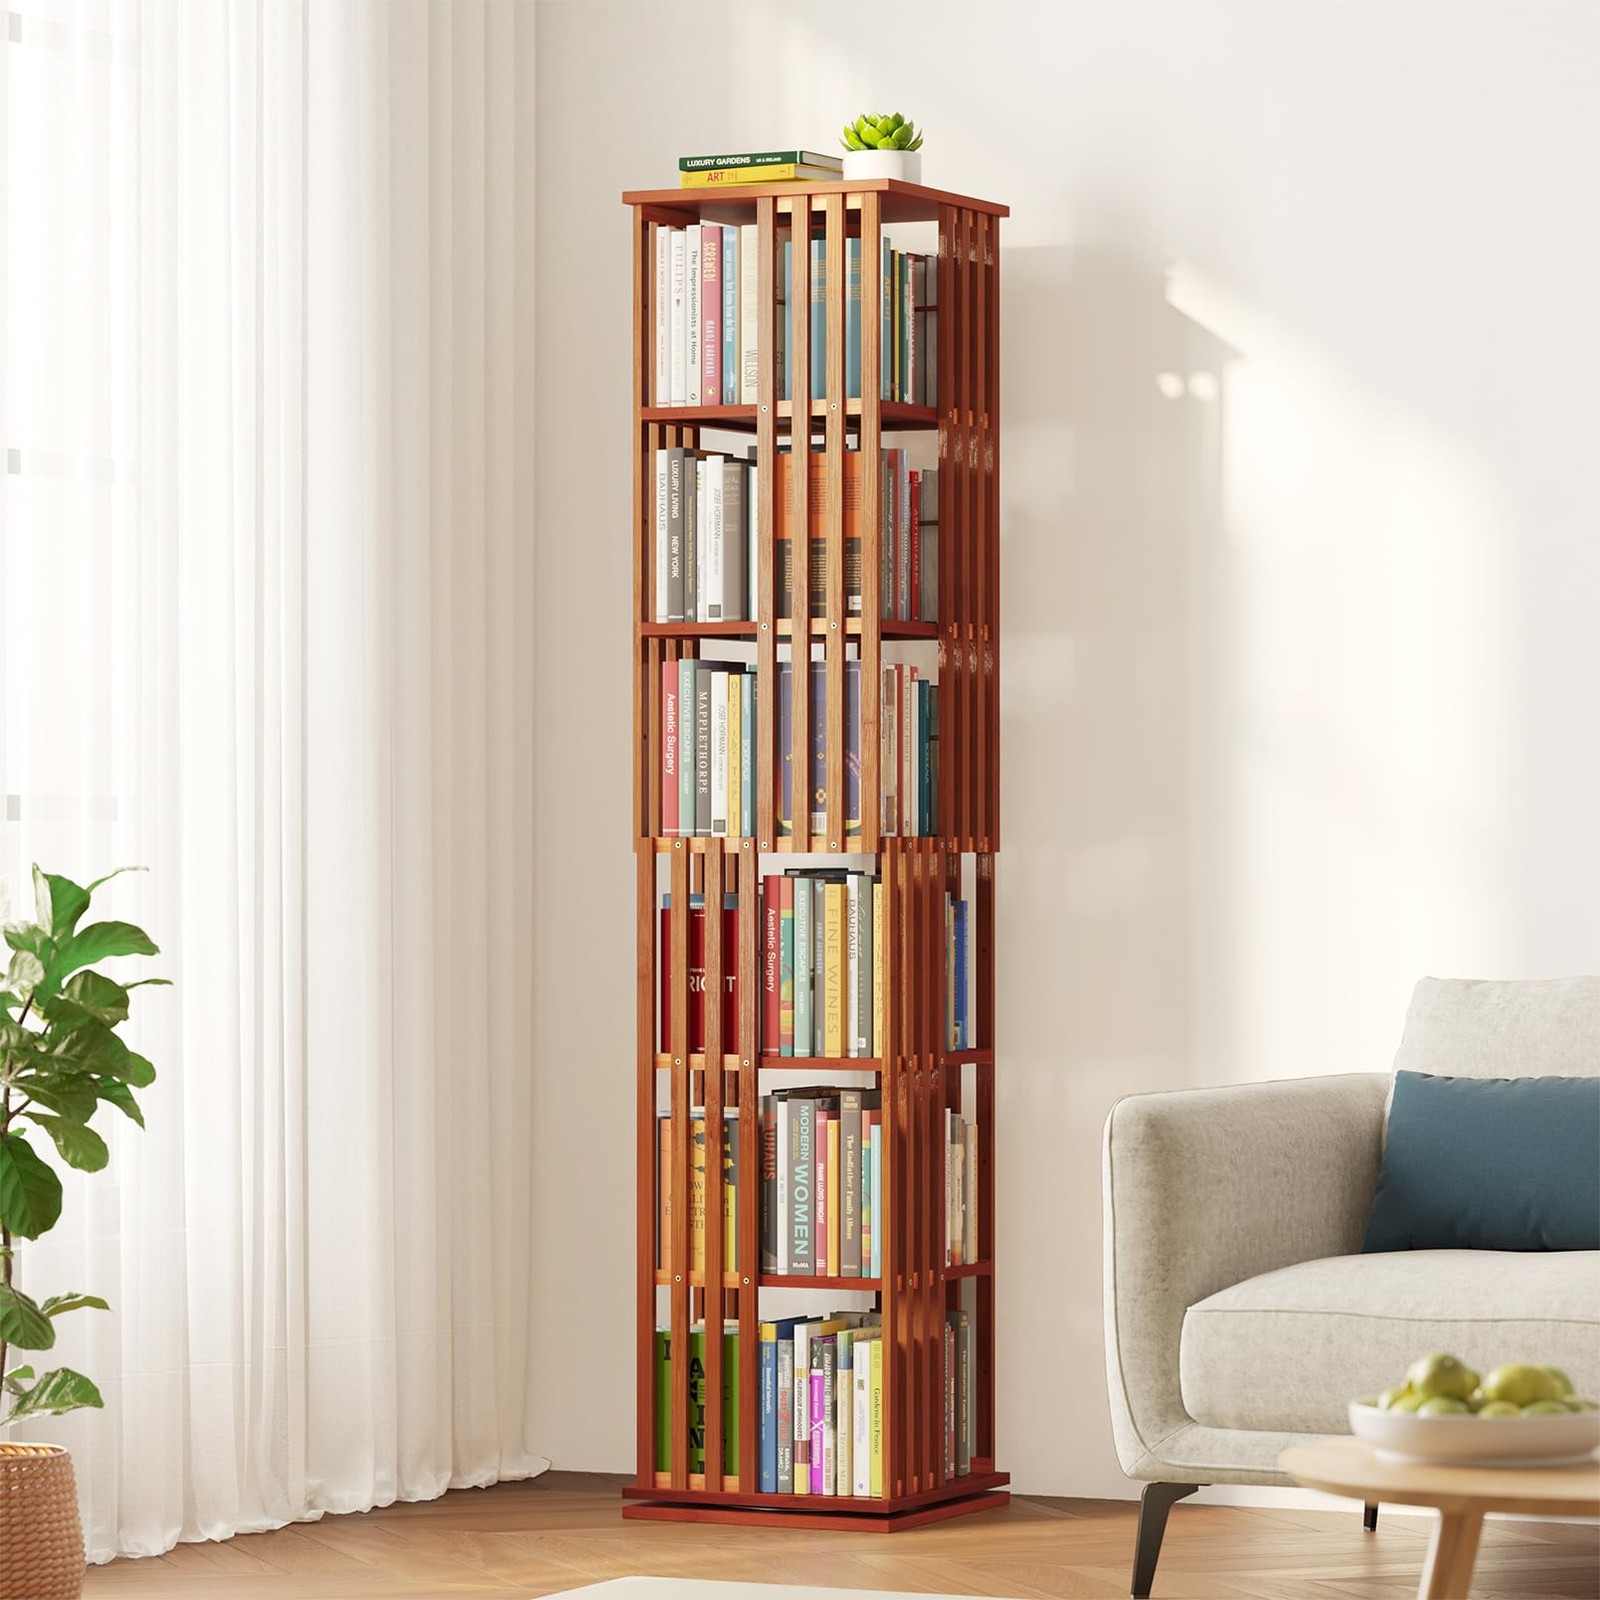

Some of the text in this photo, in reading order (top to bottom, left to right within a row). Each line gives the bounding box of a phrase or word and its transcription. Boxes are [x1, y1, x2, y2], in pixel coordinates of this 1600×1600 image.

[687, 159, 715, 167] LUXURY
[716, 156, 751, 165] GARDENS
[707, 172, 724, 182] ART
[675, 246, 683, 294] TULIPS
[689, 267, 698, 328] Impressionists
[691, 330, 697, 338] at
[671, 460, 680, 578] LUXURY LIVING NEW YORK
[683, 671, 691, 720] EXECUTIVE
[665, 693, 676, 775] Aestetic Surgery
[683, 722, 691, 763] ESCAPES
[699, 691, 708, 794] MAPPLETHORPE
[765, 908, 776, 992] Aestetic Surgery
[828, 908, 838, 1034] FINE WINES
[763, 1113, 777, 1180] BAUHAUS
[800, 1105, 809, 1160] MODERN
[794, 1163, 809, 1255] WOMEN
[846, 1134, 854, 1240] The Godfather Family Album
